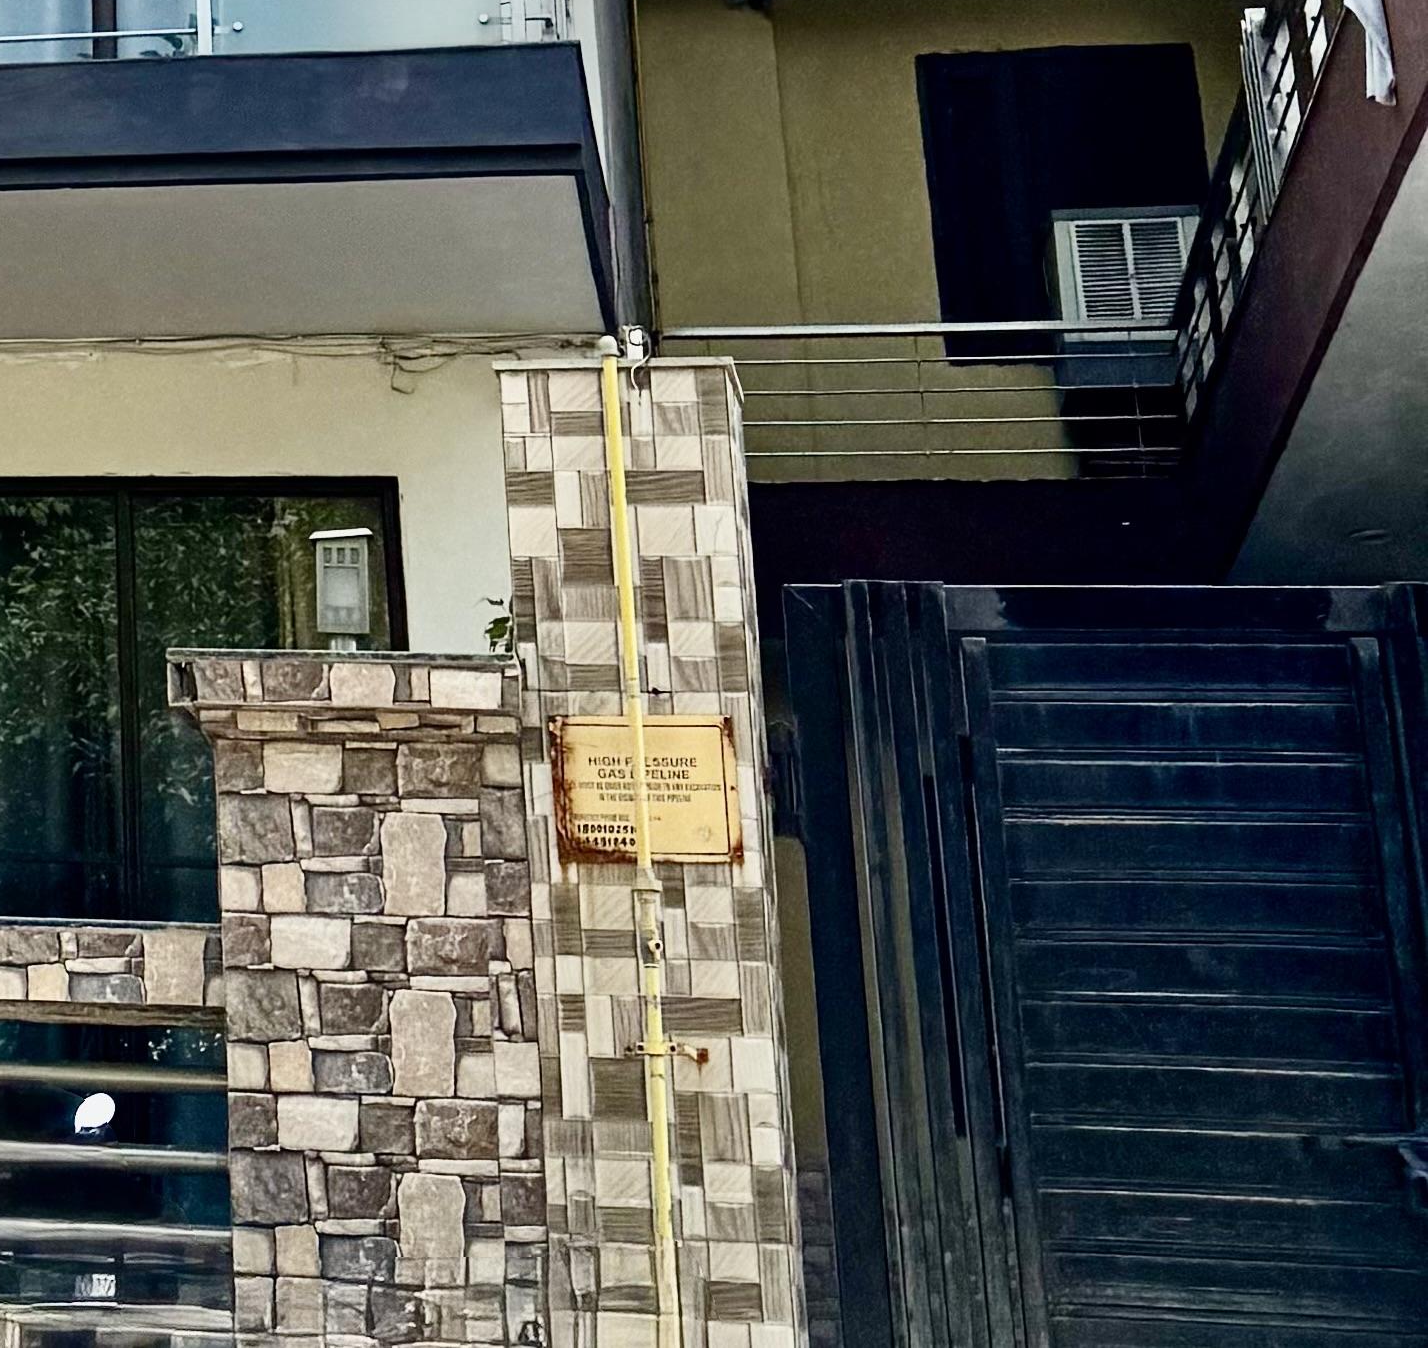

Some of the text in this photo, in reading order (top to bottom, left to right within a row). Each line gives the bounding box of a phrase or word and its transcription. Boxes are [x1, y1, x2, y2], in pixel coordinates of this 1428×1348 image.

[588, 756, 697, 768] HIGH PESSURE
[597, 768, 626, 779] GAS
